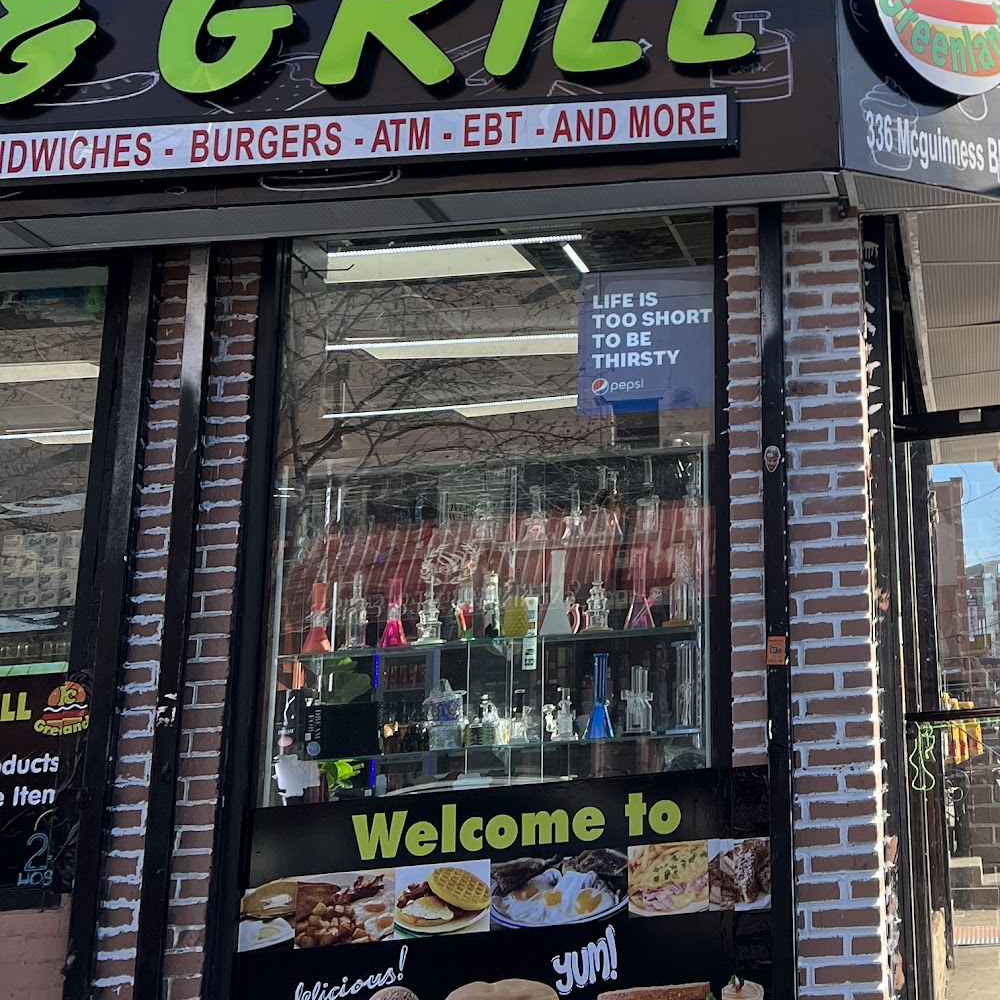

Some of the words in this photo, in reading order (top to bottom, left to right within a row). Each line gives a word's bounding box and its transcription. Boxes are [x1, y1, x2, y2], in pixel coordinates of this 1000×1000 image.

[189, 121, 342, 164] BURGERS
[371, 116, 431, 153] ATM
[463, 111, 523, 148] EBT
[552, 107, 617, 144] AND
[629, 101, 717, 140] MORE
[865, 110, 893, 153] 336
[897, 116, 985, 172] Mcguinness
[592, 293, 634, 309] LIFE
[639, 291, 658, 307] IS
[591, 312, 637, 329] TOO
[641, 308, 713, 327] SHORT
[591, 333, 621, 349] TO
[626, 331, 652, 347] BE
[591, 349, 680, 369] THIRSTY
[610, 378, 644, 393] pepsi
[0, 752, 60, 776] ducts
[351, 803, 606, 861] Welcome
[624, 792, 682, 837] to
